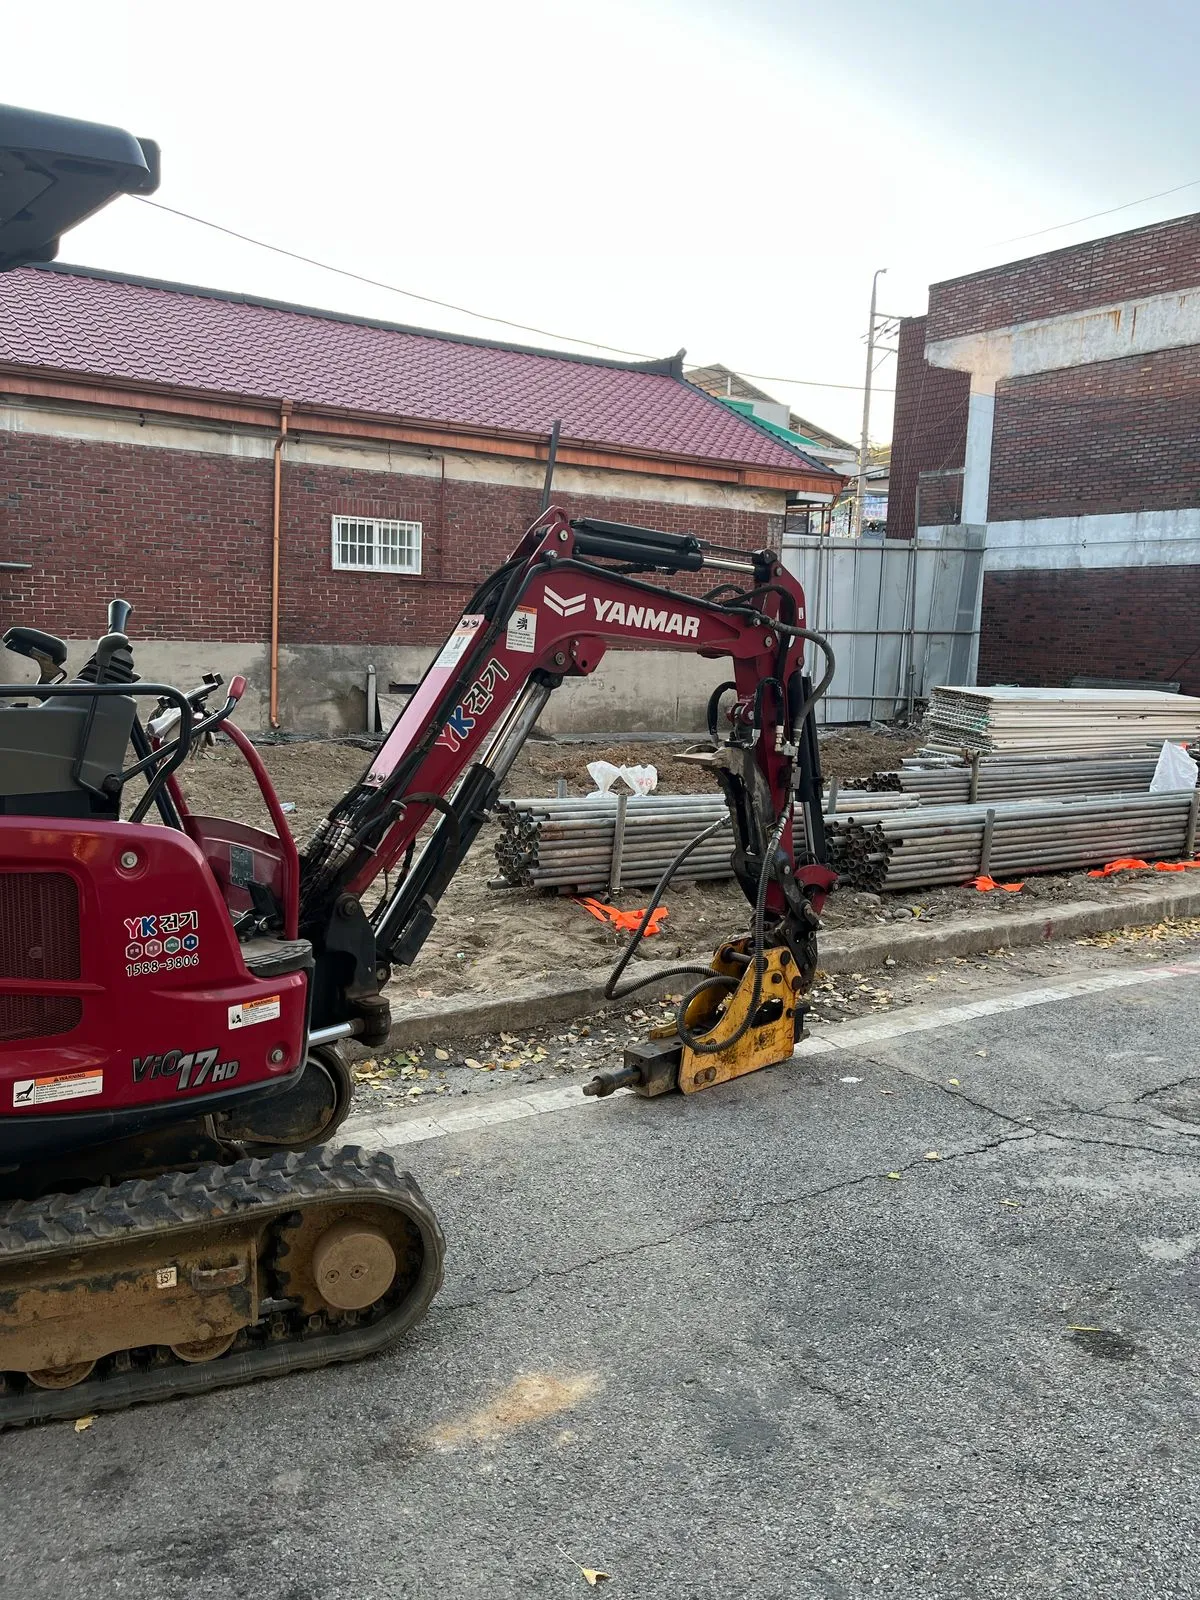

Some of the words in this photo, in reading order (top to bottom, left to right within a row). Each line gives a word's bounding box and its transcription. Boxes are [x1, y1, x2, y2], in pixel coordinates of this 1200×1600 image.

[593, 597, 701, 638] YANMAR
[435, 705, 476, 752] YK
[124, 915, 157, 939] YK
[126, 953, 199, 977] 1588-3806
